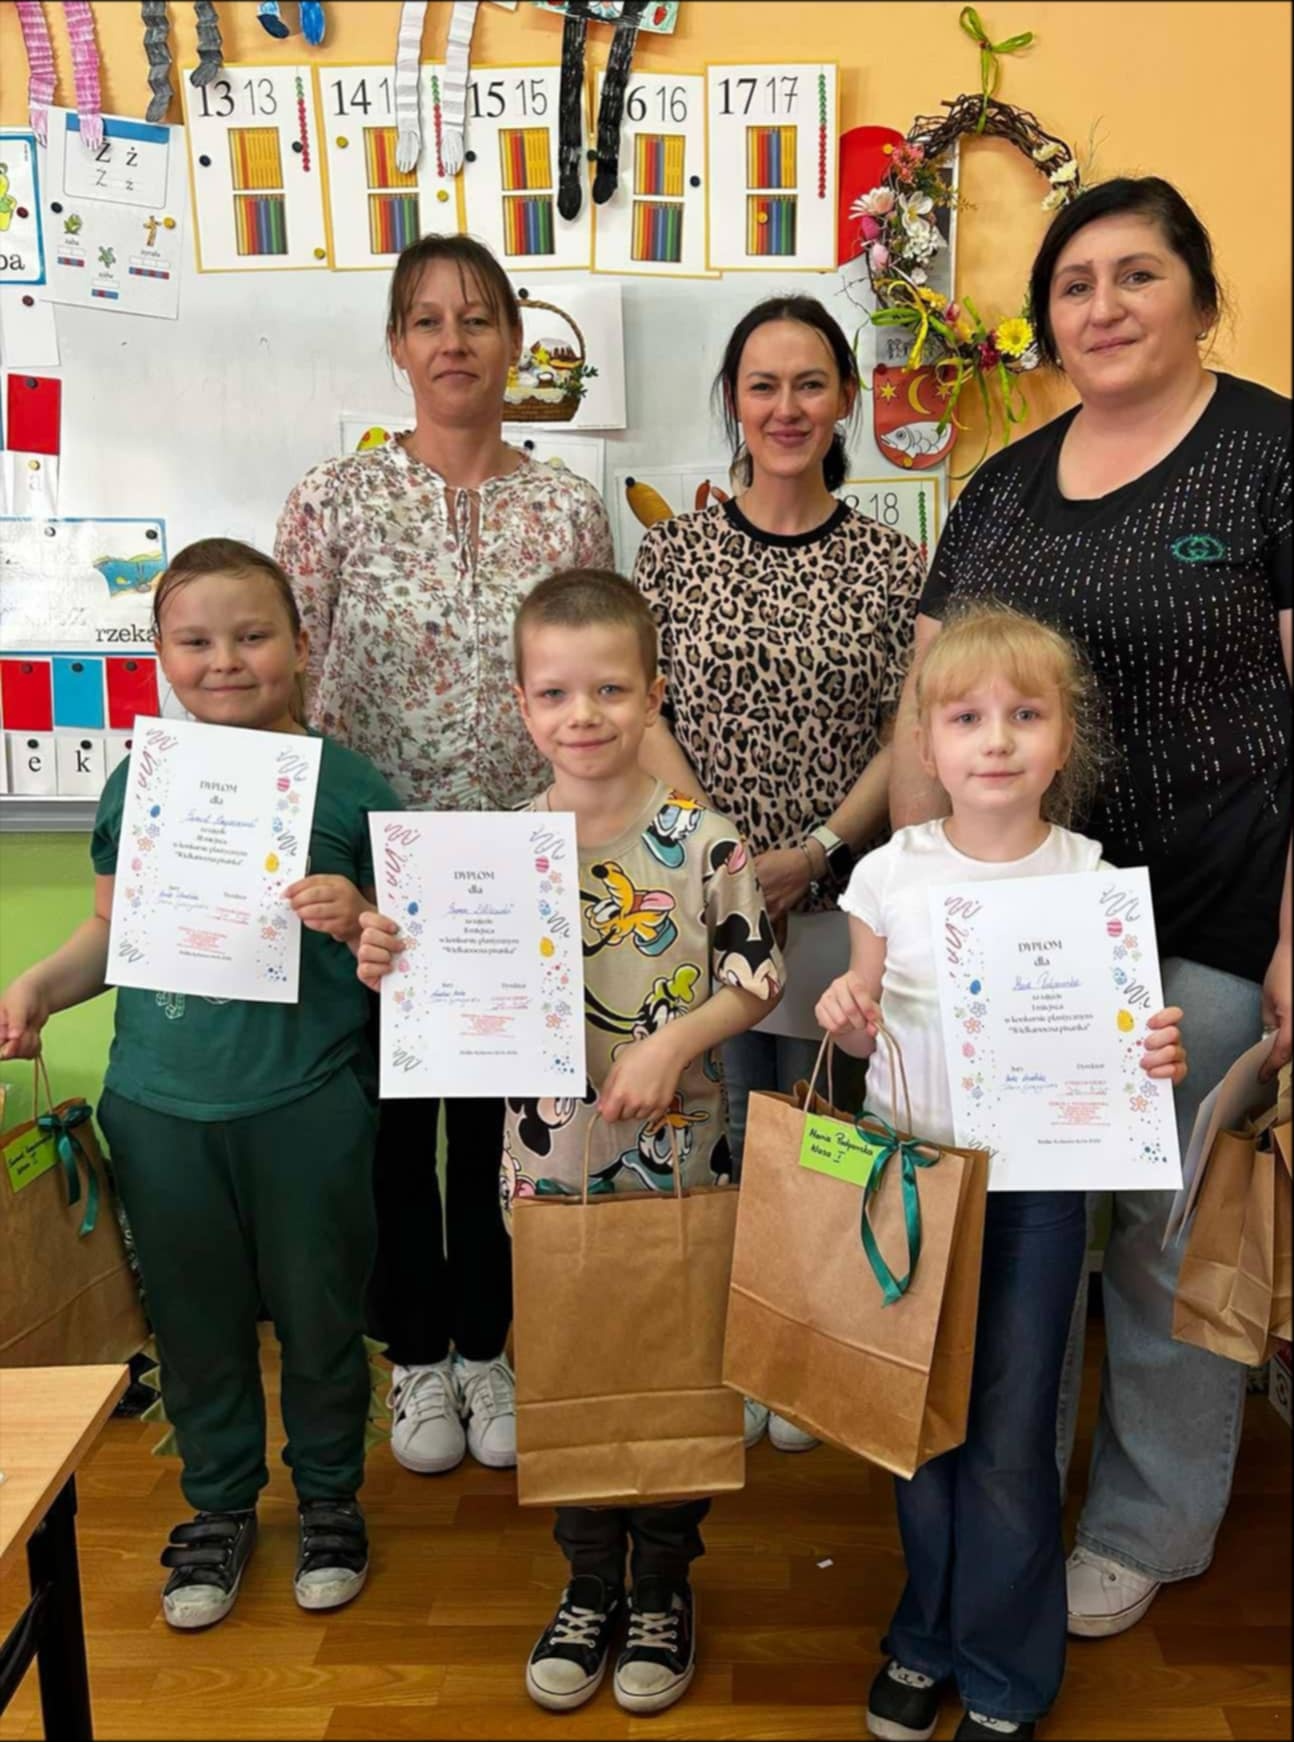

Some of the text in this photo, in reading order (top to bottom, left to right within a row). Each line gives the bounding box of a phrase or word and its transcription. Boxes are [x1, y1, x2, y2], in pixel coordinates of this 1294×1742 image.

[198, 77, 278, 117] 13 13
[331, 79, 372, 116] 14
[468, 79, 548, 118] 15 15
[626, 85, 687, 123] 6 16
[718, 76, 798, 115] 17 17
[126, 146, 138, 167] ż
[869, 492, 900, 526] 18
[28, 756, 42, 772] e
[76, 750, 91, 773] k
[1018, 939, 1063, 952] DYPLOM
